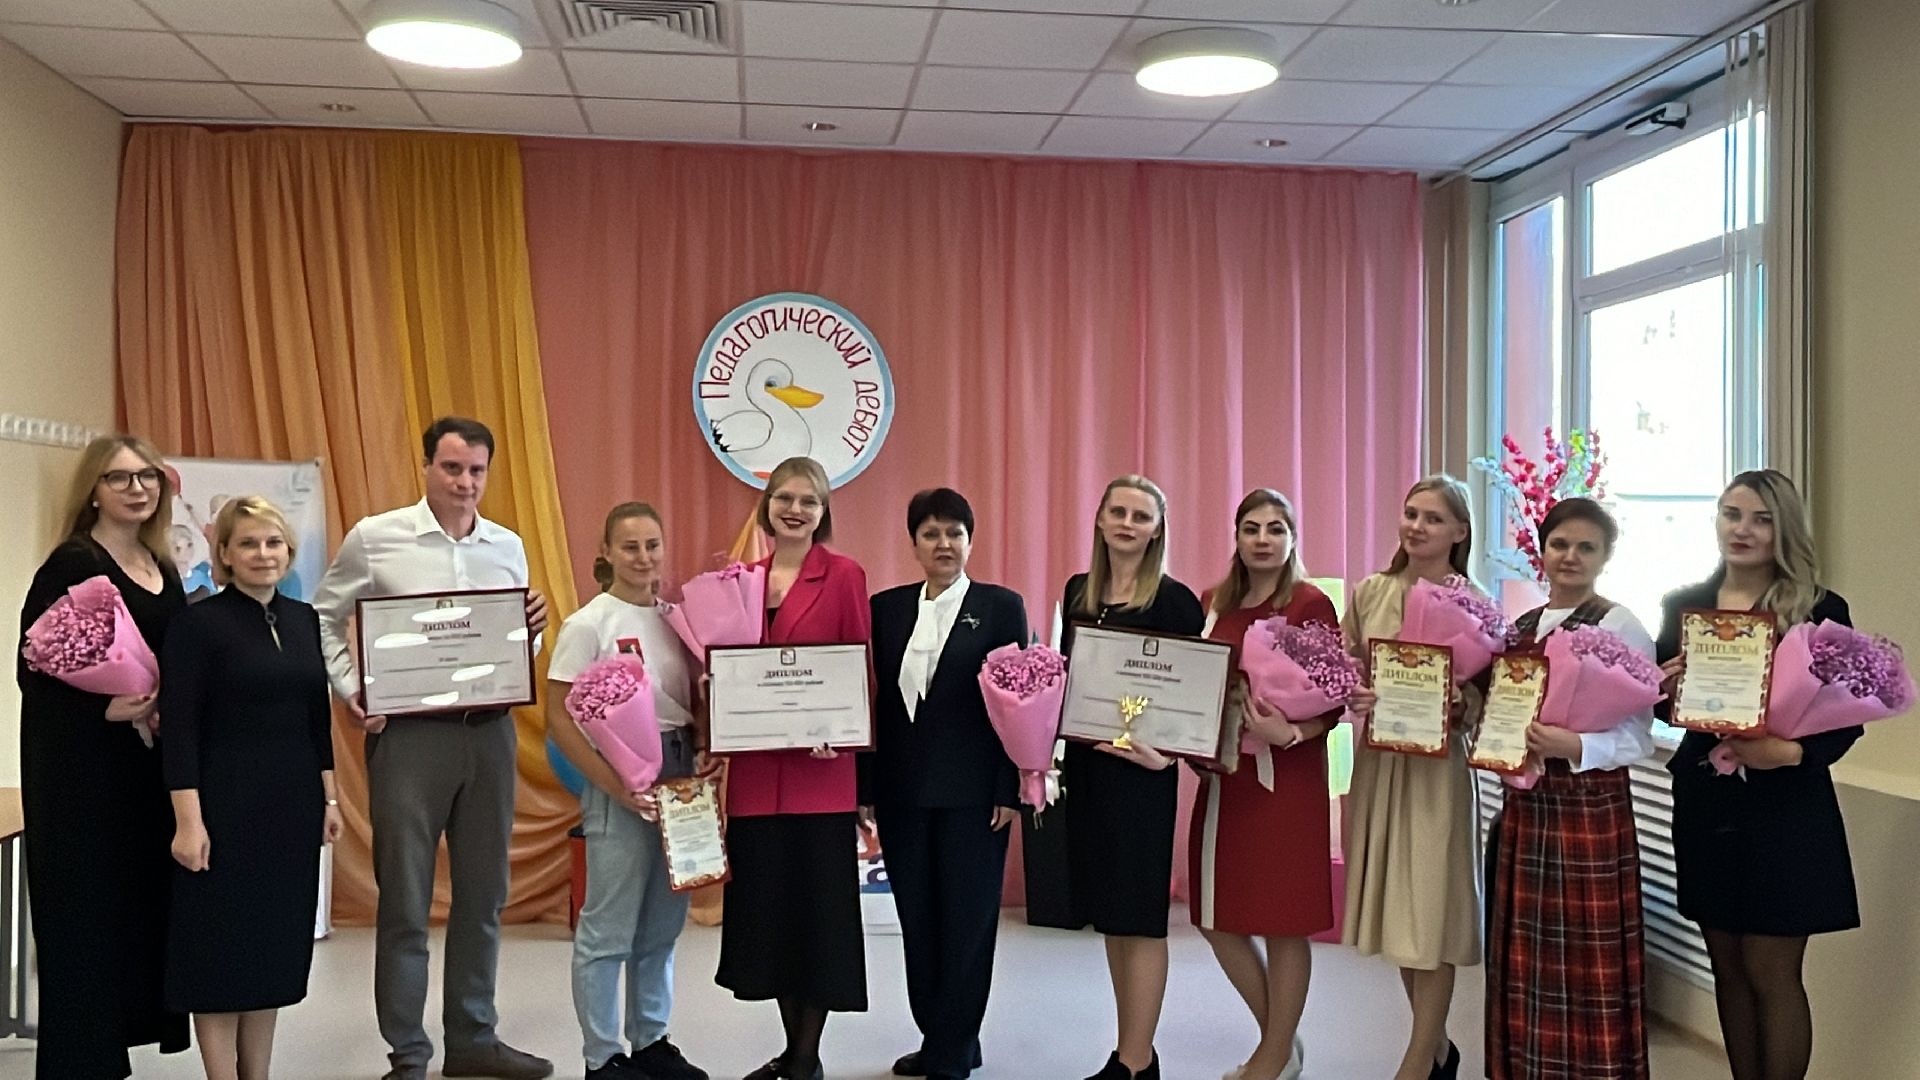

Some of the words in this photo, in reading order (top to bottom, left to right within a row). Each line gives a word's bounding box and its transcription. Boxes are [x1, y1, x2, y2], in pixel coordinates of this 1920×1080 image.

[698, 307, 872, 400] Педагогический
[421, 621, 471, 633] ДИПЛОМ
[1694, 643, 1758, 655] ДИПЛОМ
[1123, 659, 1173, 673] ДИПЛОМ
[764, 669, 813, 679] ДИПЛОМ
[1381, 668, 1438, 684] ДИПЛОМ
